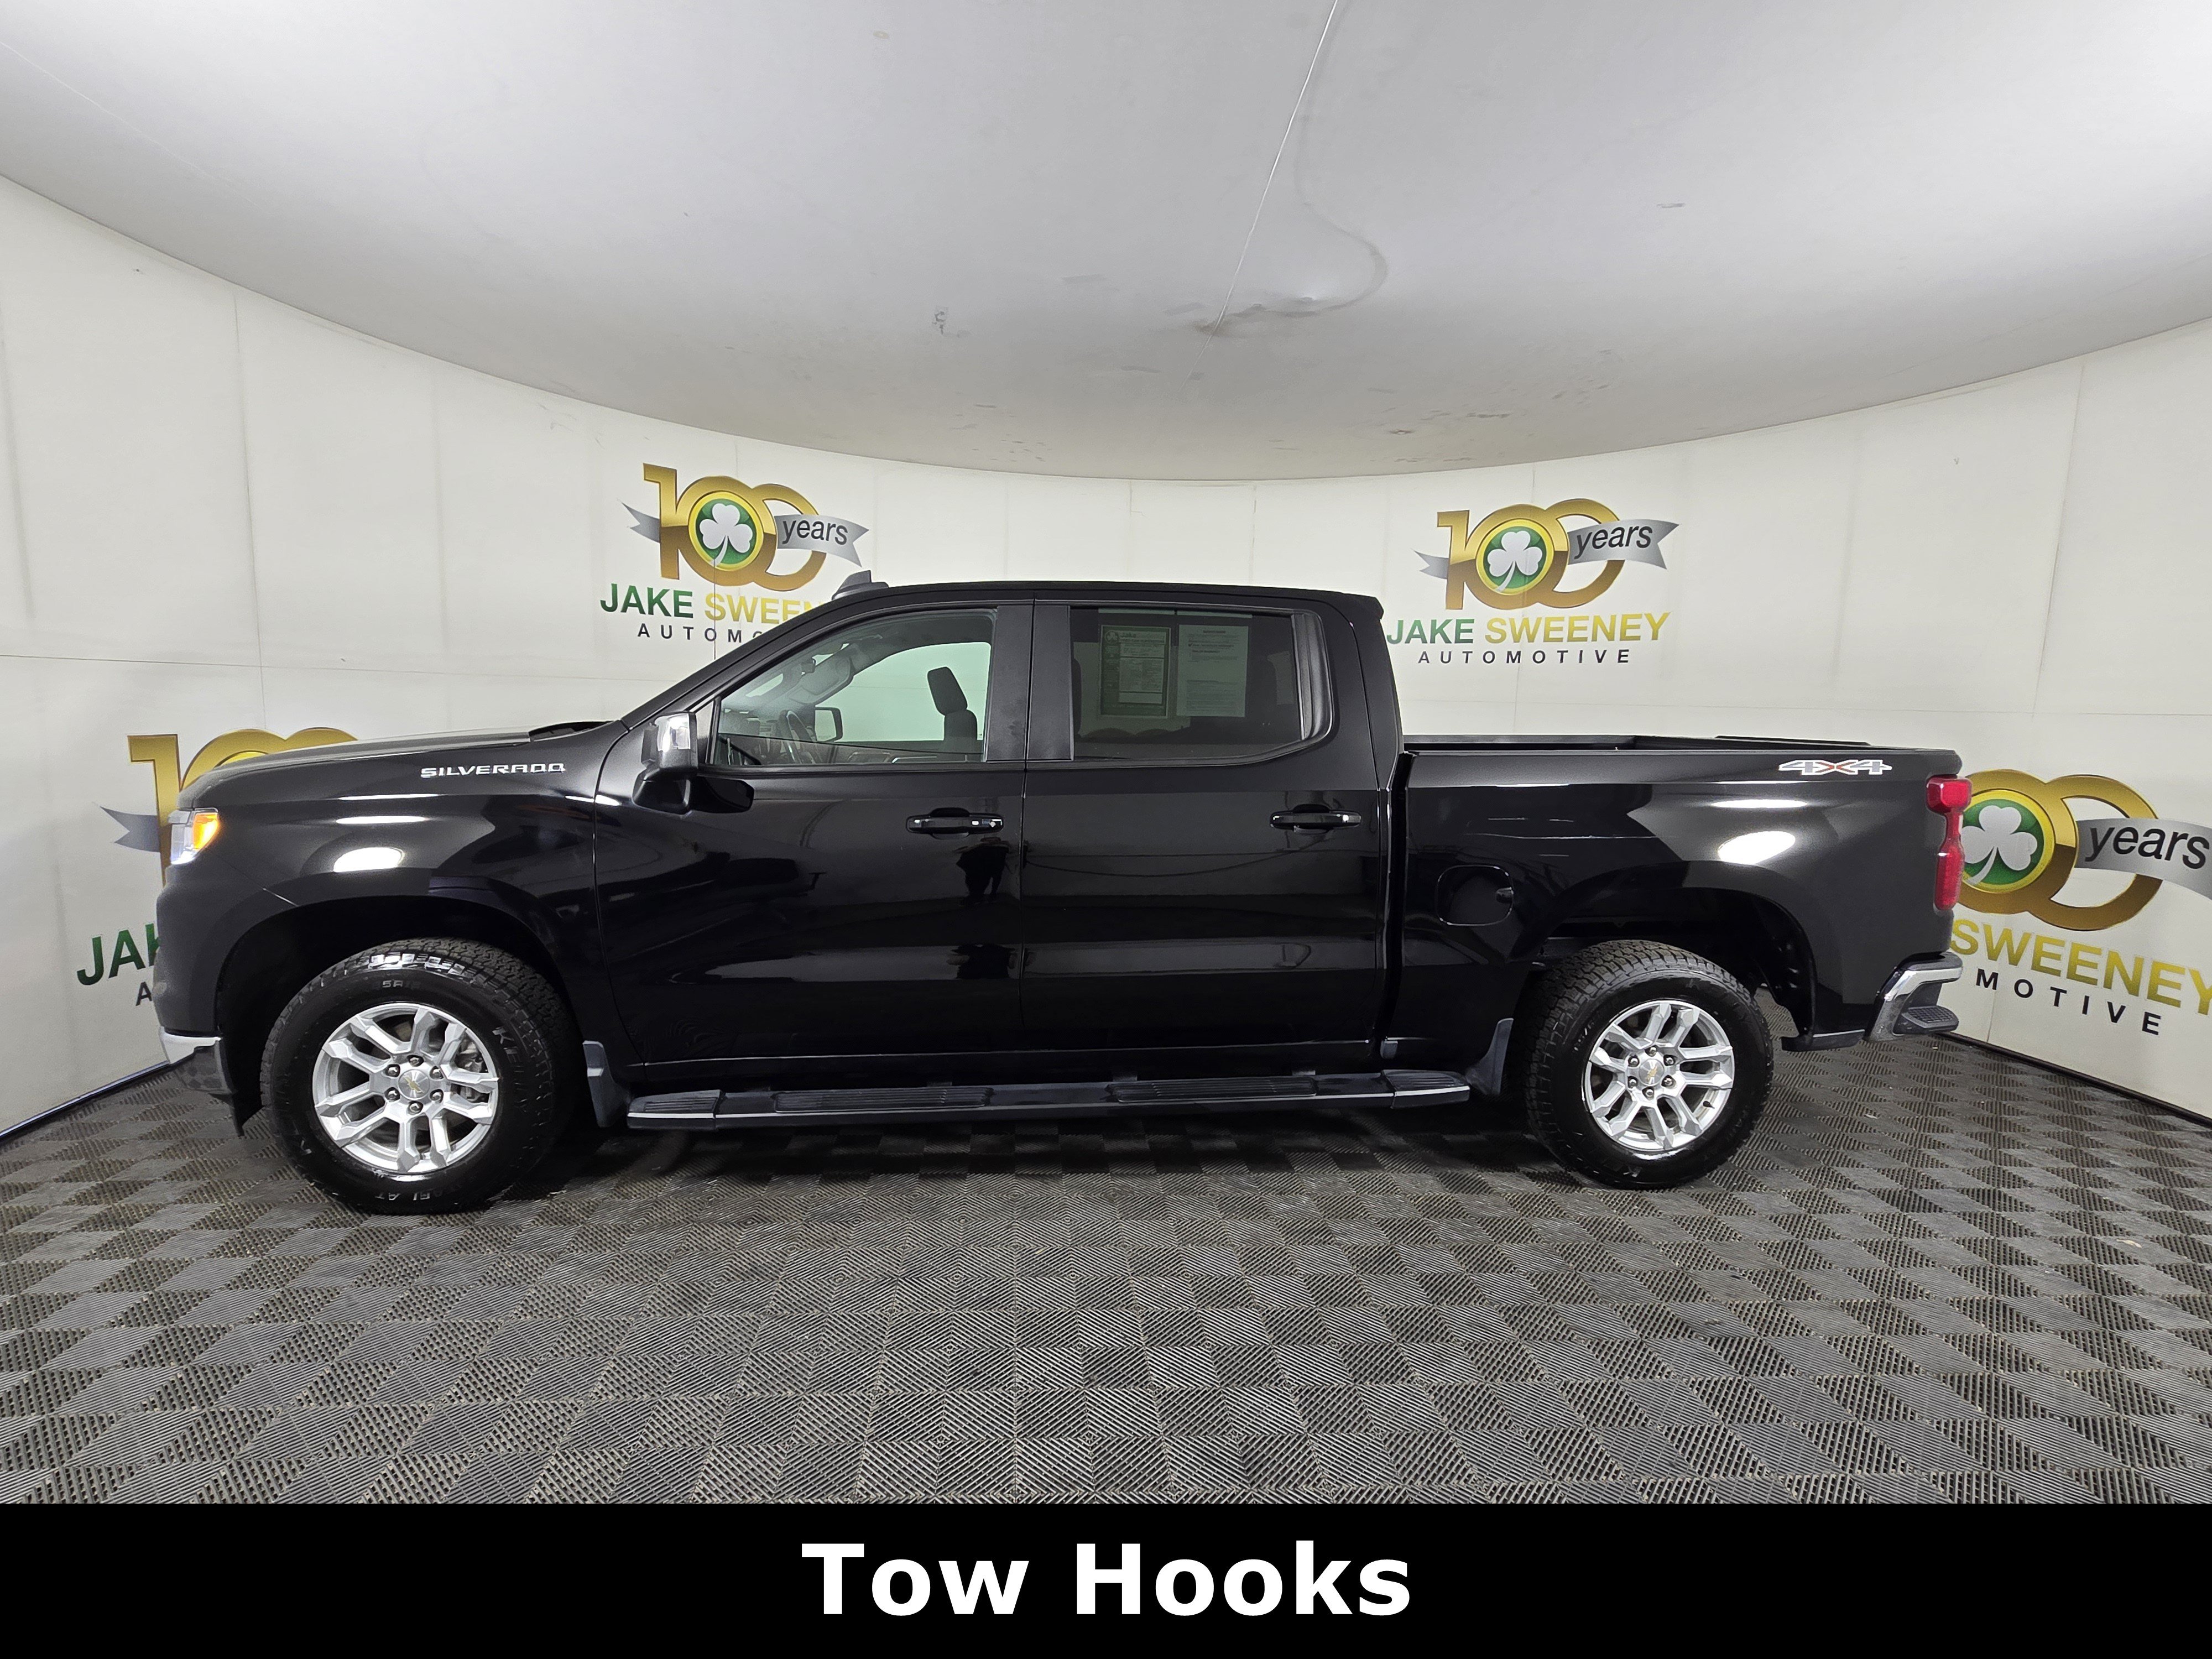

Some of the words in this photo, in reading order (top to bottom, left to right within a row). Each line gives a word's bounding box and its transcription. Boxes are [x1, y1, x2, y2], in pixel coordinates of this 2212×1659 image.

[643, 463, 827, 592] 100
[782, 516, 848, 546] years
[1574, 524, 1653, 559] years
[1437, 498, 1624, 610] 100
[600, 583, 694, 619] JAKE
[705, 592, 822, 624] SWEE
[1386, 618, 1474, 644] JAKE
[1485, 612, 1671, 644] SWEENEY
[1418, 649, 1629, 664] AUTOMOTIVE
[421, 763, 565, 778] SILVERADO
[2084, 825, 2210, 869] years
[1950, 919, 2212, 1015] SWEENEY
